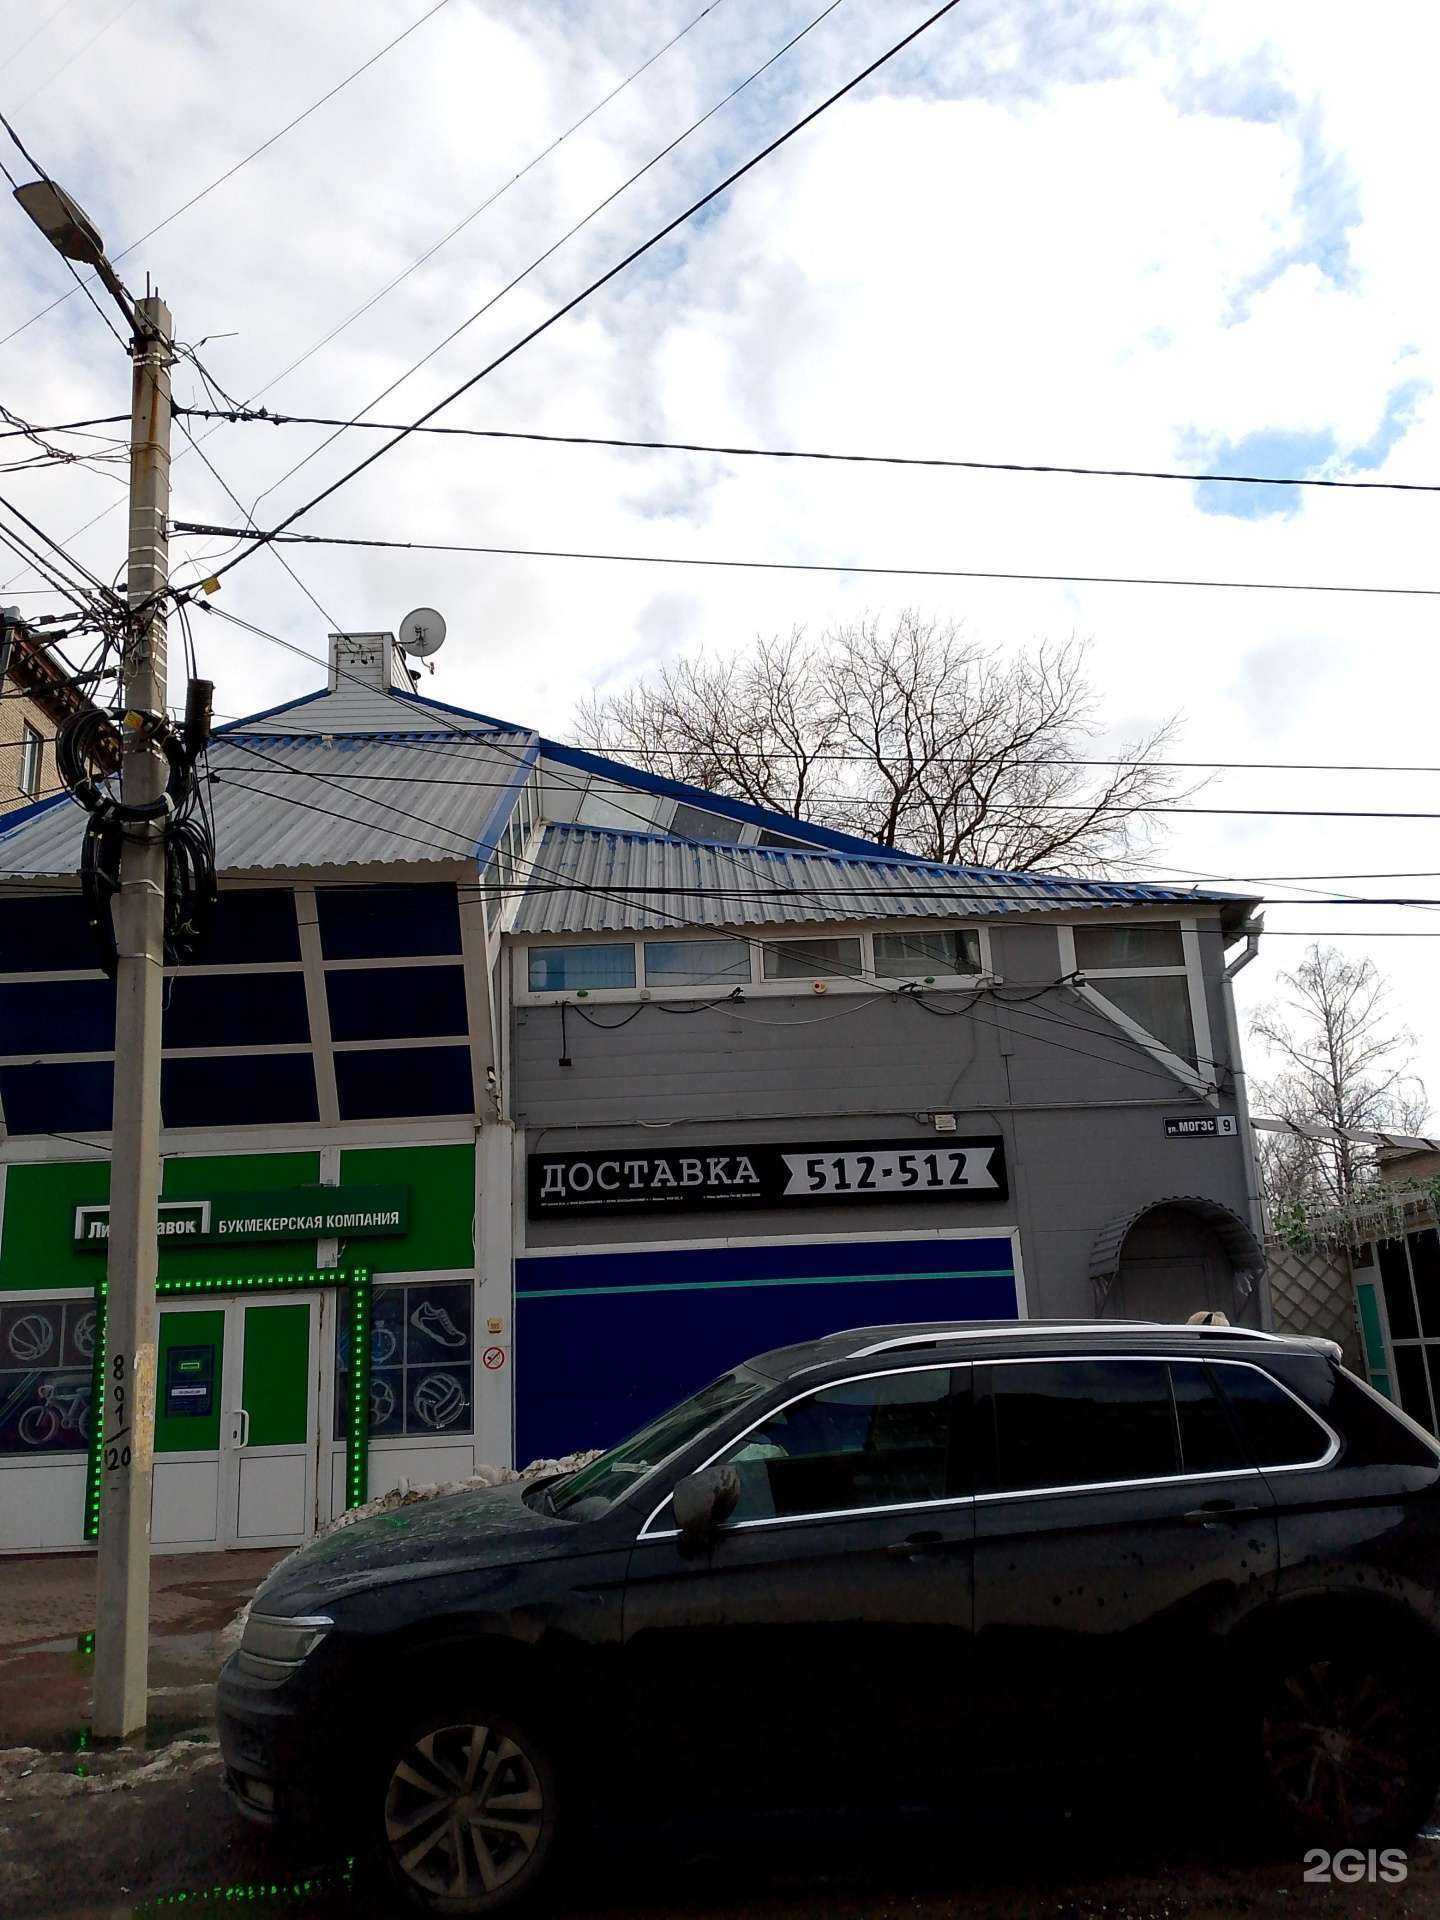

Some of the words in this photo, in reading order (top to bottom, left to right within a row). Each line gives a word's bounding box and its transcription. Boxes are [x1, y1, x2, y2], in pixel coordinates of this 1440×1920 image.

[1179, 1121, 1214, 1132] МОГЭС
[1223, 1119, 1231, 1132] 9
[540, 1156, 760, 1197] ДОСТАВКА
[806, 1152, 969, 1192] 512-512
[218, 1215, 323, 1233] БУКМЕКЕРСКАЯ
[326, 1211, 400, 1228] КОМПАНИЯ
